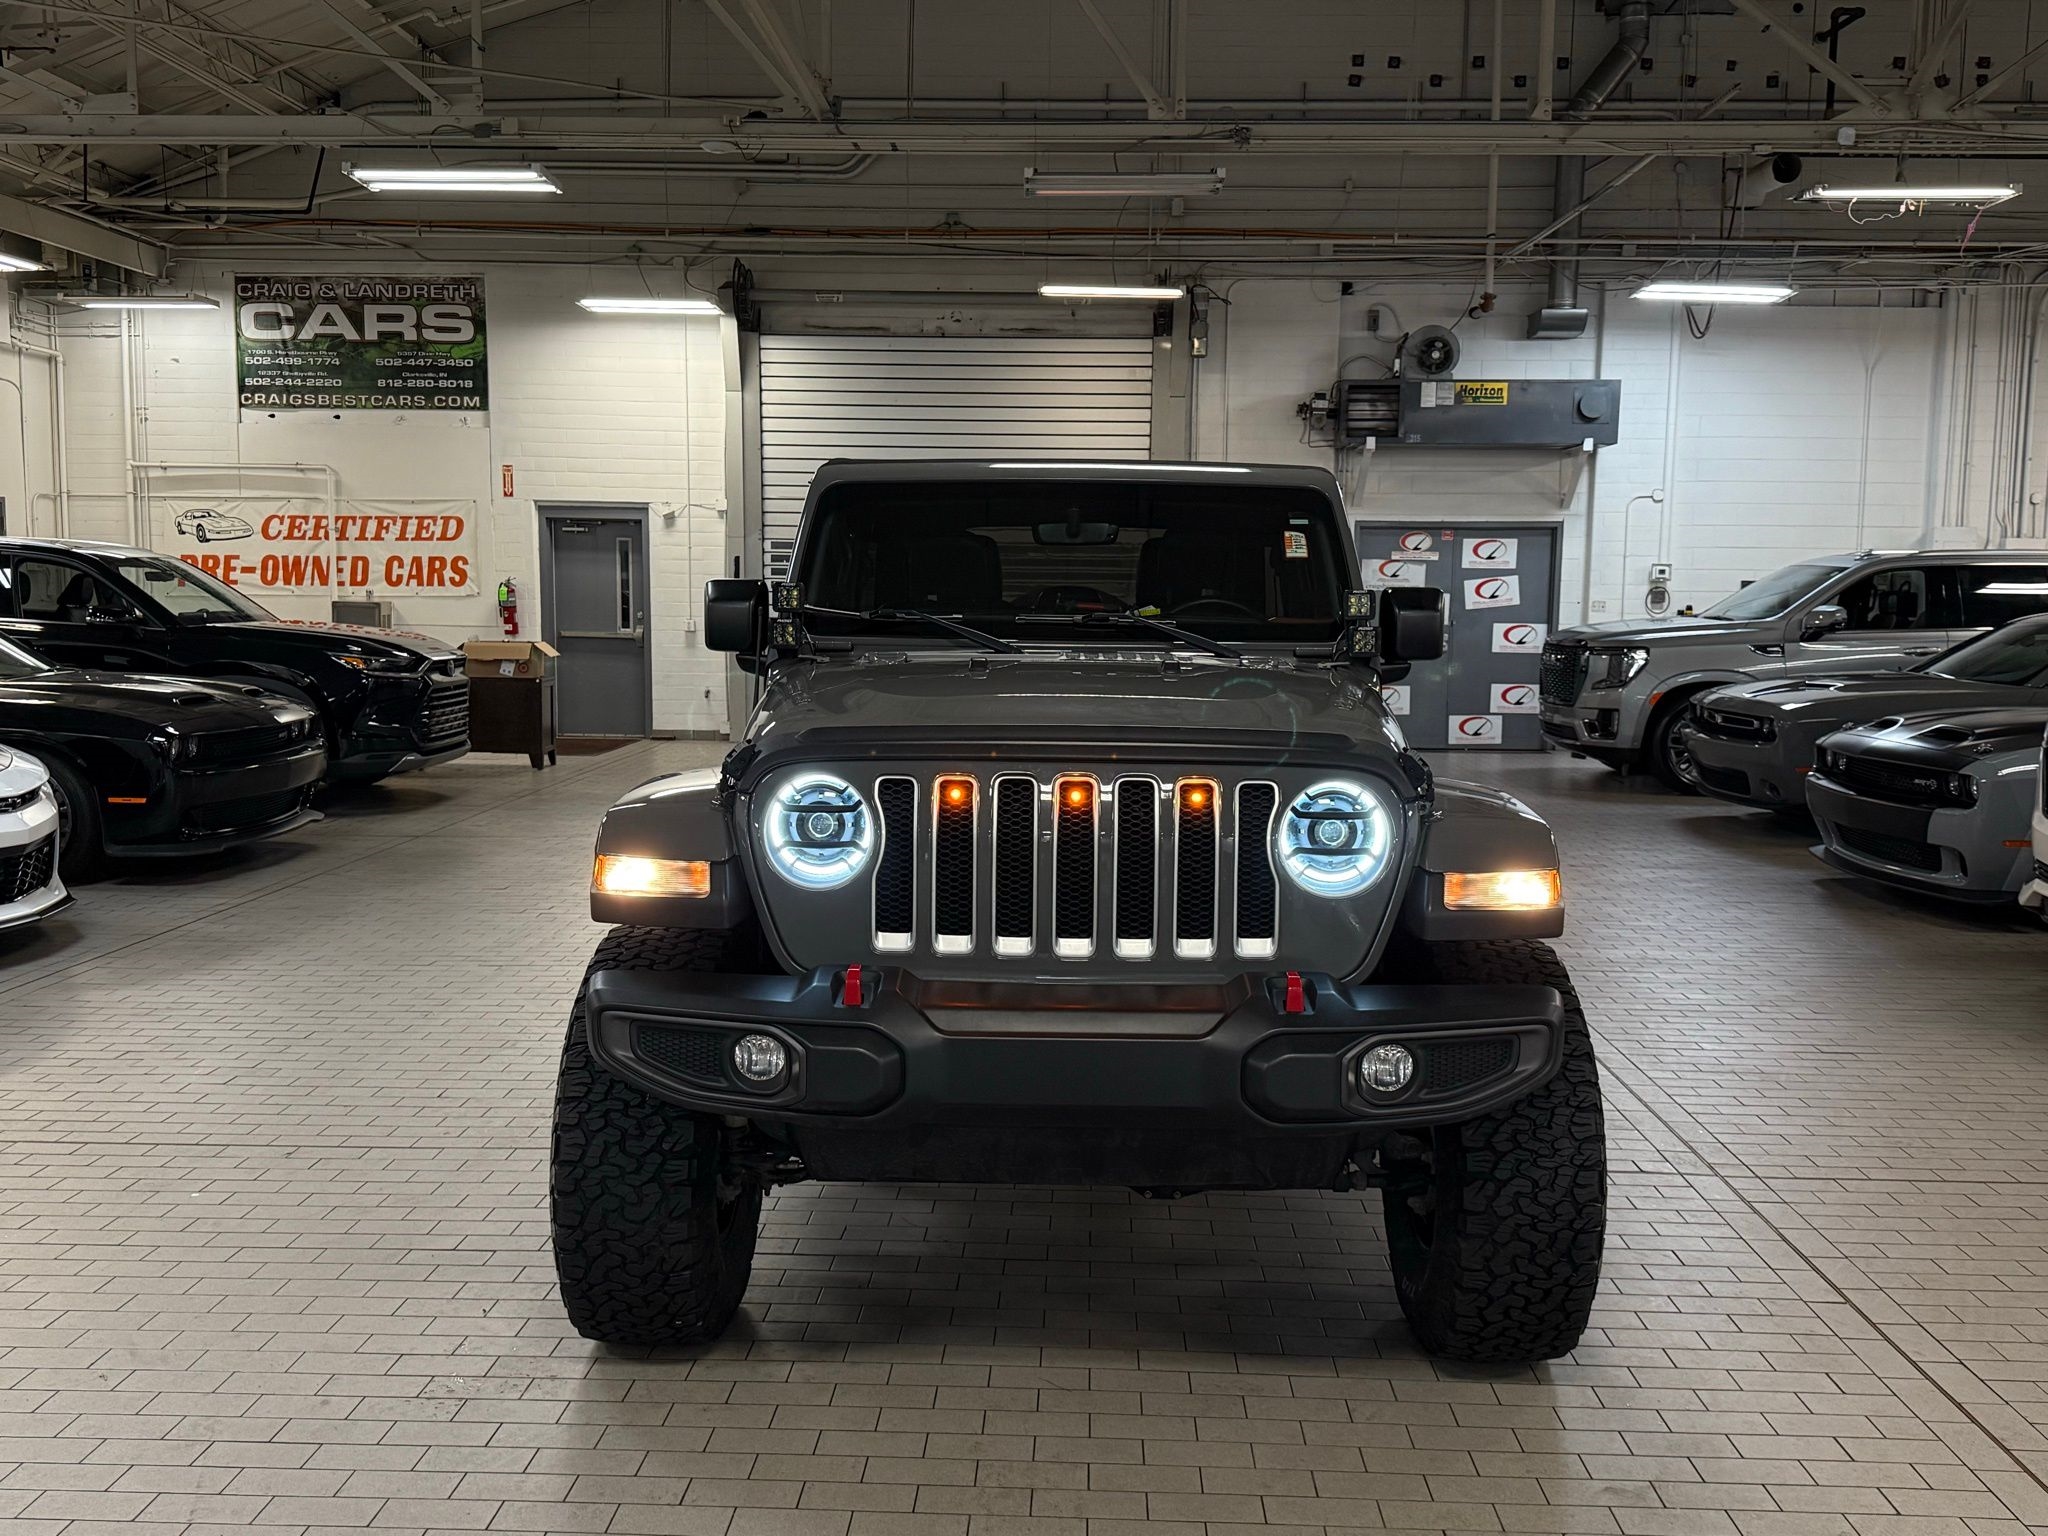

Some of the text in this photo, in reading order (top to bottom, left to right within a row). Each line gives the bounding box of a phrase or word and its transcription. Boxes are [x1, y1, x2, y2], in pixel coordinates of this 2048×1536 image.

[237, 283, 476, 298] CRAIG & LANDRETH
[239, 302, 475, 342] CARS
[244, 356, 341, 366] 502-499-1774
[375, 358, 474, 367] 502-447-3450
[244, 377, 342, 387] 502-244-2220
[1460, 383, 1504, 396] Horizon
[240, 393, 481, 408] CRAIGSBESTCARS.COM
[260, 514, 466, 542] CERTIFIED
[384, 555, 470, 588] CARS
